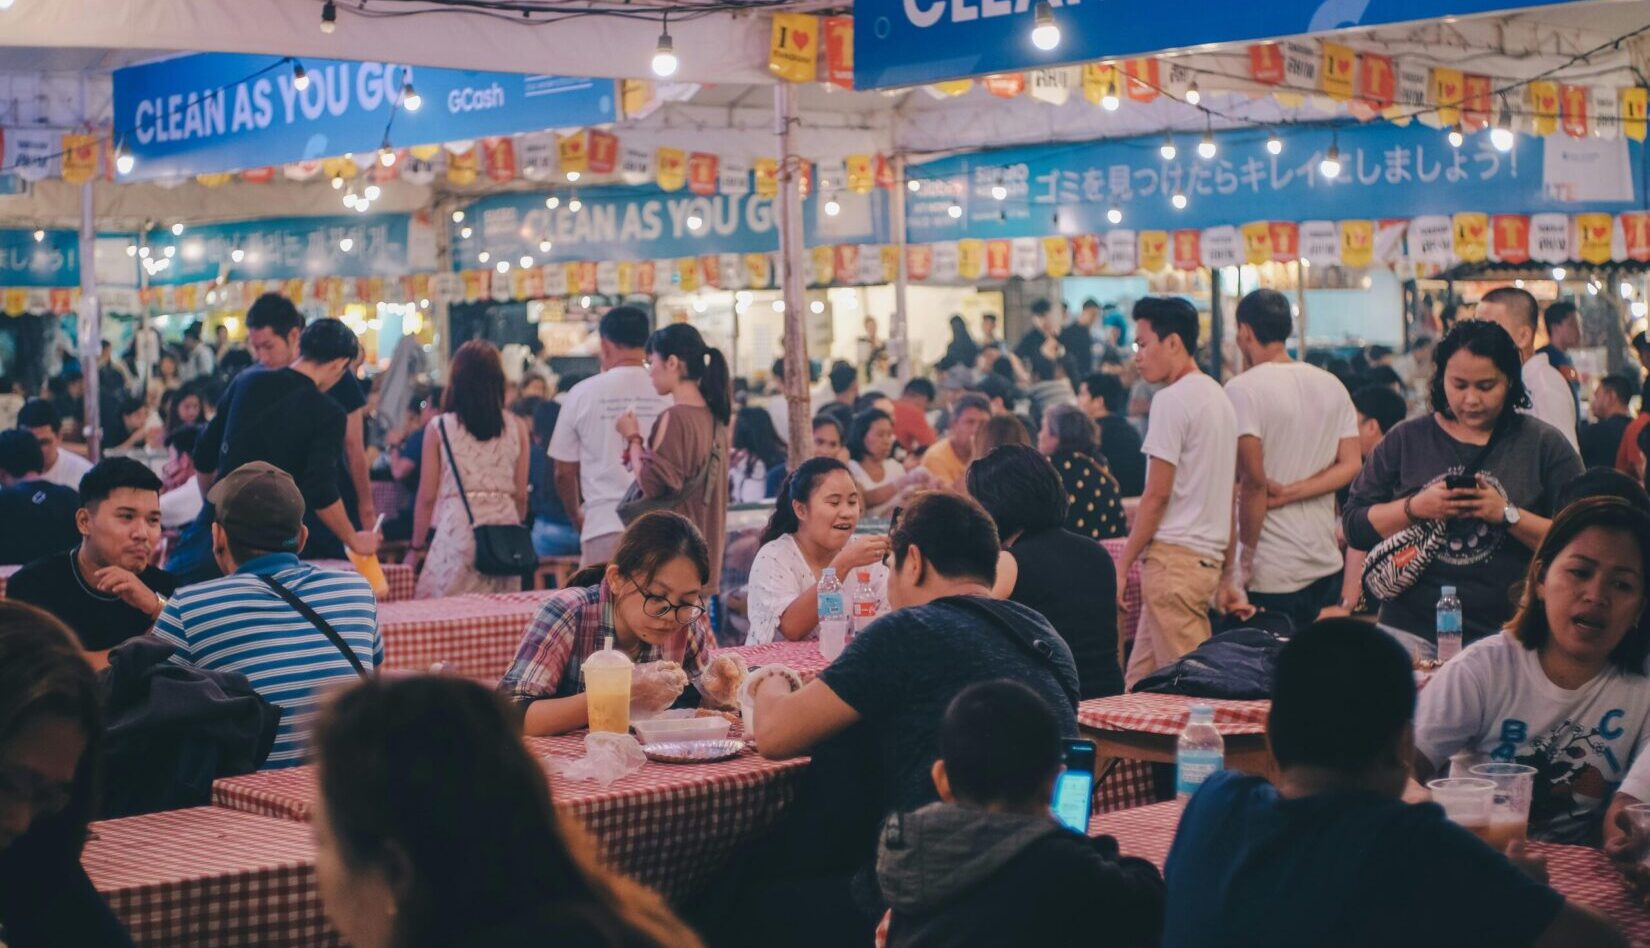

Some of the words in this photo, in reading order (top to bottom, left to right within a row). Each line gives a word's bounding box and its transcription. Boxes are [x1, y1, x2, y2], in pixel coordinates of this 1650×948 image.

[779, 27, 787, 48] I
[135, 88, 226, 145] CLEAN
[231, 78, 273, 133] AS
[277, 63, 350, 125] YOU
[356, 61, 414, 111] GO
[448, 81, 505, 114] GCash
[522, 203, 616, 246] CLEAN
[620, 200, 662, 241] AS
[667, 195, 739, 238] YOU
[1501, 718, 1528, 743] B
[1600, 708, 1625, 740] C
[1603, 745, 1622, 774] I
